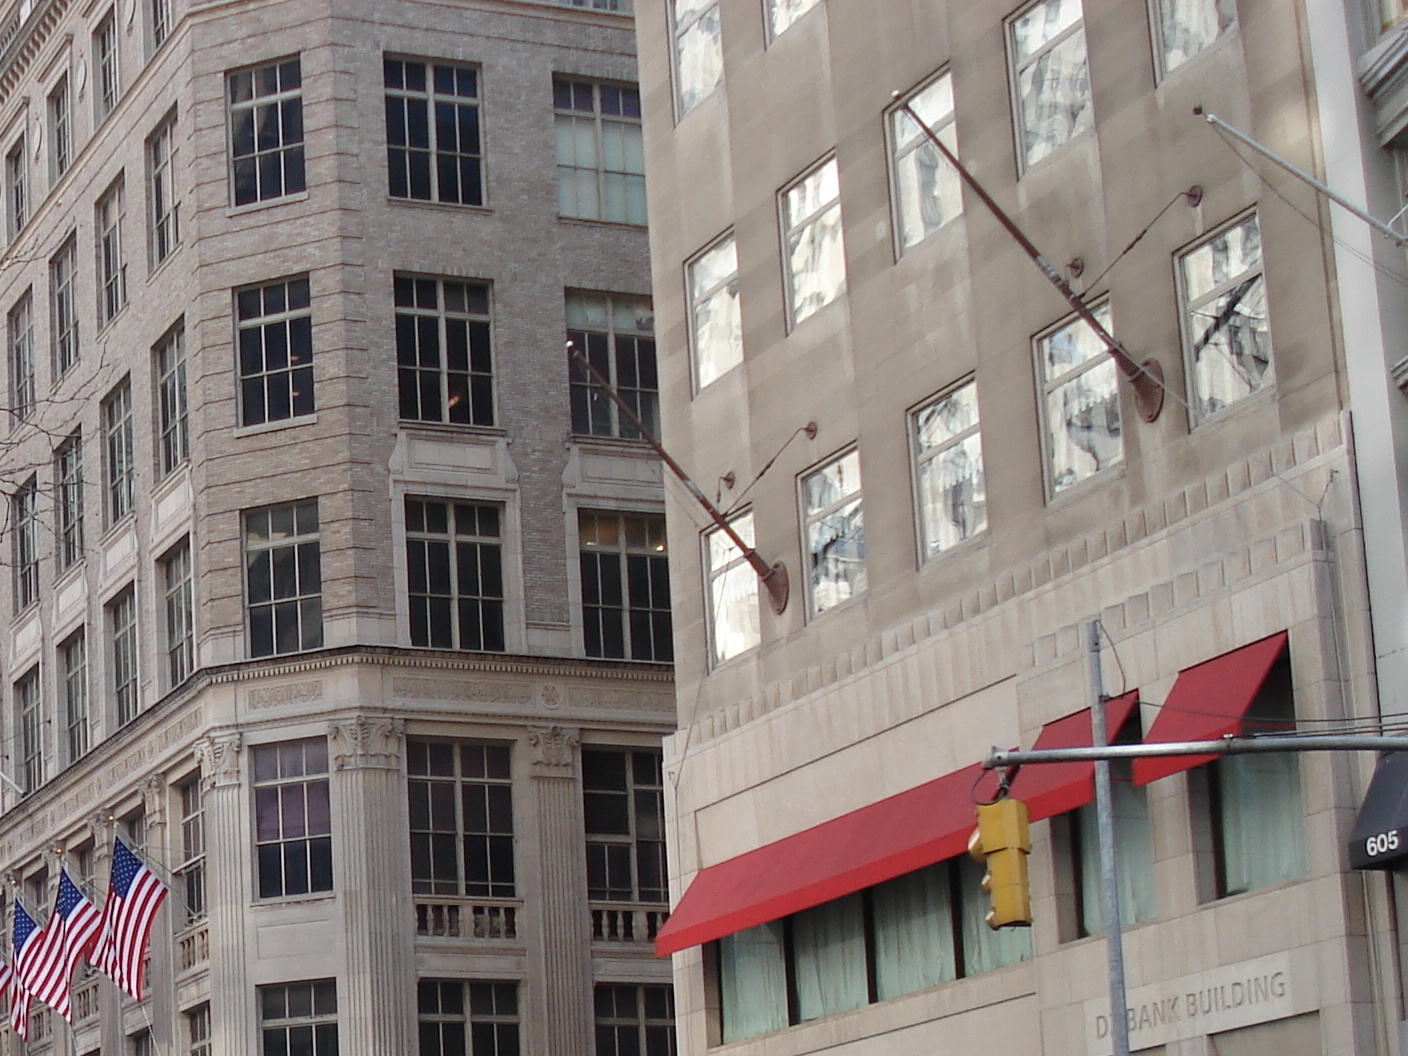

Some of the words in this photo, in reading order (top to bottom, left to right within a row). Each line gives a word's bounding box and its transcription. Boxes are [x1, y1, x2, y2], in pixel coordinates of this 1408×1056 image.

[1366, 830, 1398, 856] 605
[1126, 996, 1181, 1033] BANK
[1186, 971, 1285, 1019] BUILDING
